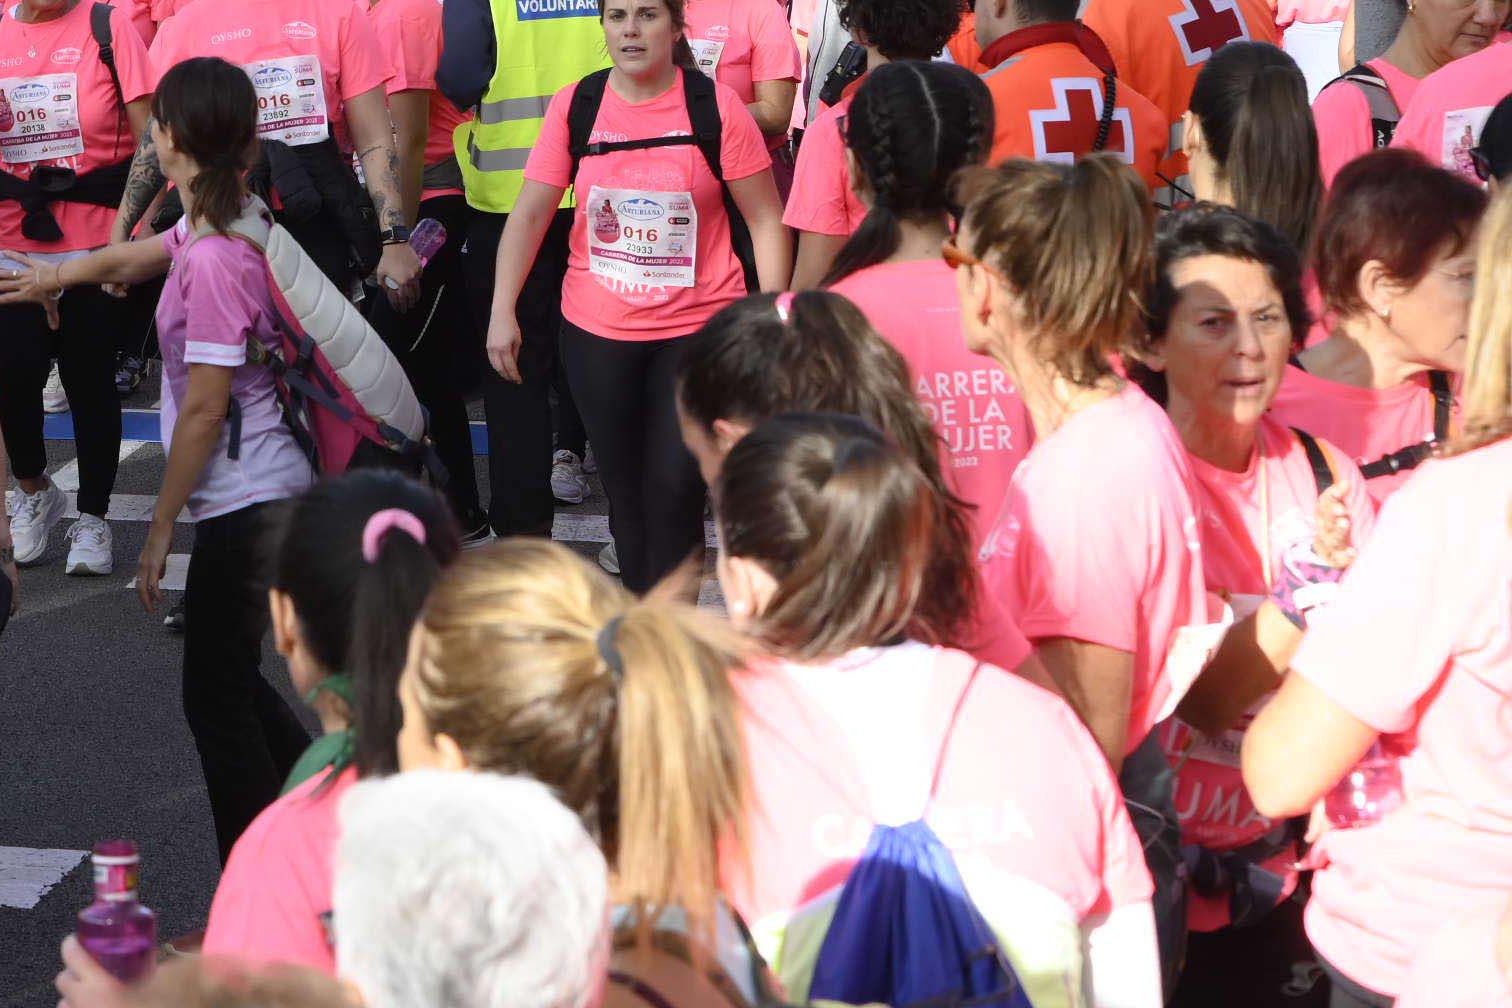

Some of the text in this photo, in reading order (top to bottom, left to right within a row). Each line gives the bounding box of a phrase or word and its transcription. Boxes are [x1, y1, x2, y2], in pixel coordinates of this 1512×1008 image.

[258, 94, 291, 109] 016
[16, 108, 47, 122] 016
[263, 110, 289, 121] 23892
[22, 123, 46, 134] 20138
[623, 226, 658, 242] 016
[626, 243, 653, 255] 23933
[969, 396, 1006, 423] LA
